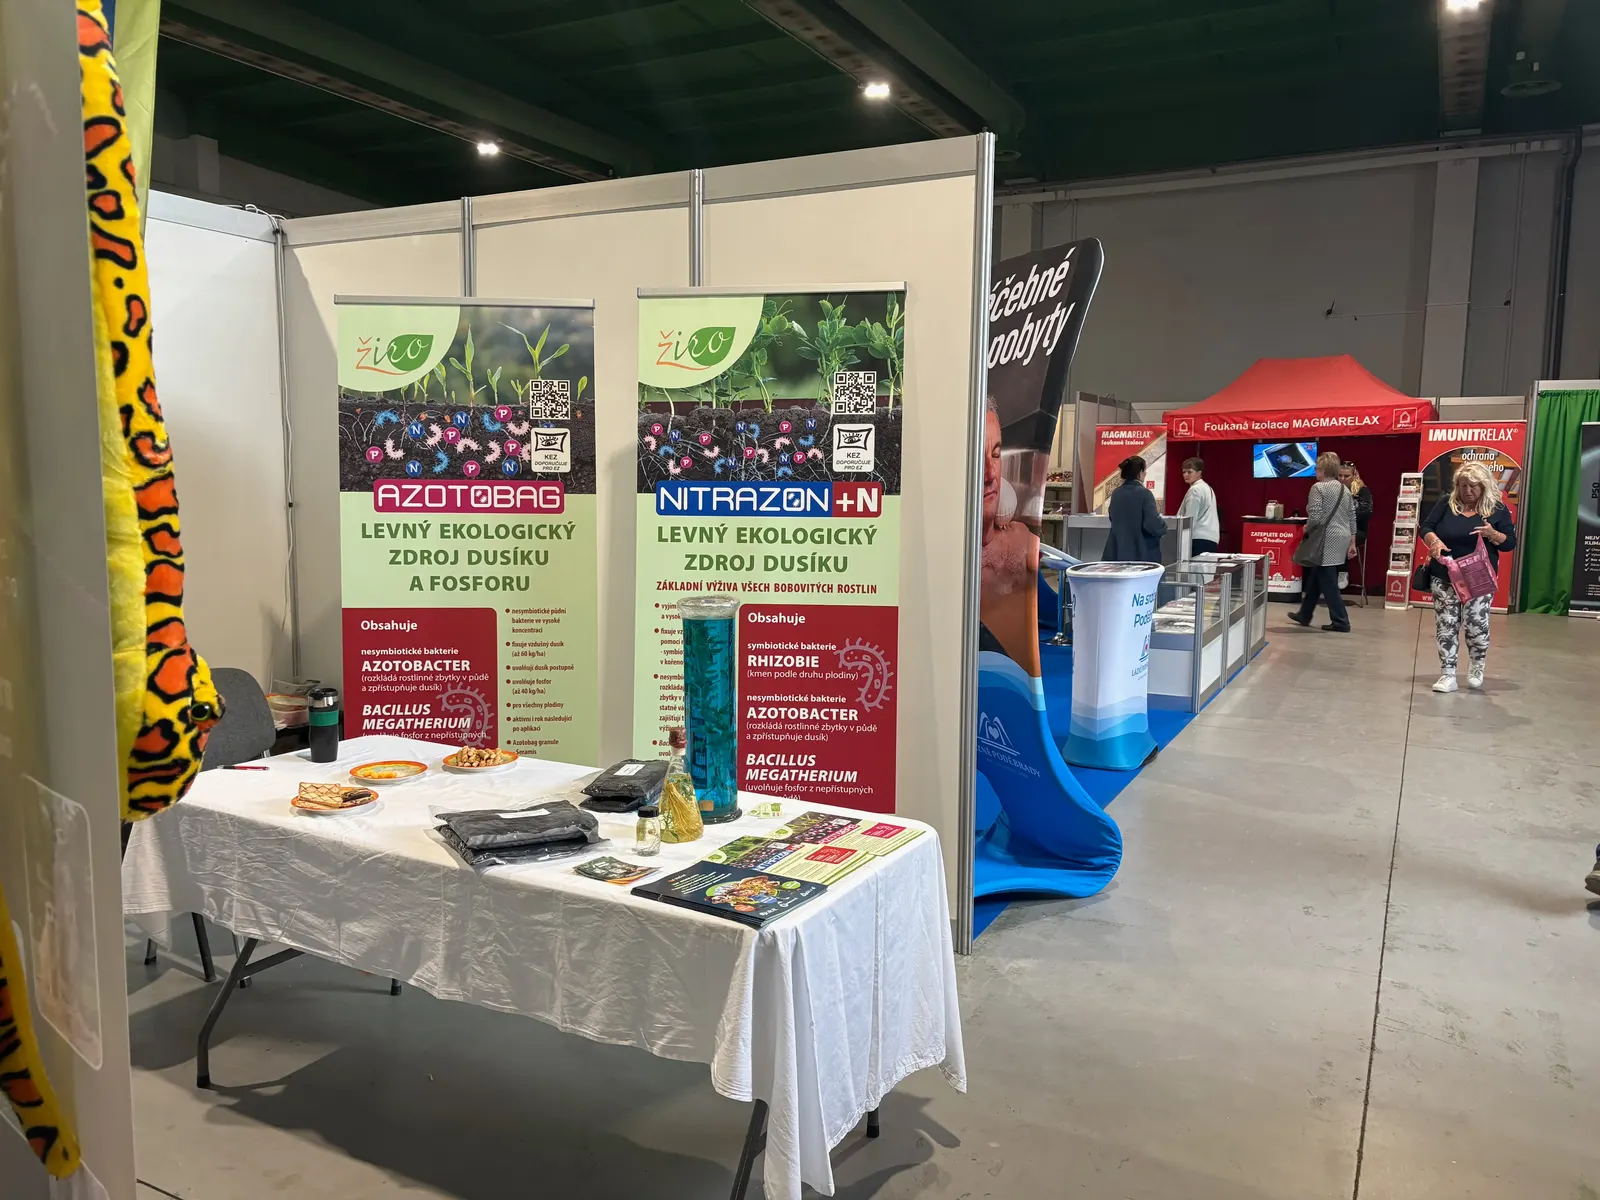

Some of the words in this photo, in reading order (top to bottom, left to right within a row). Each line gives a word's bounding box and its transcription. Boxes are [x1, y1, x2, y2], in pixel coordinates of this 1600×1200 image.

[457, 414, 466, 423] N
[499, 410, 507, 418] P
[412, 424, 421, 434] N
[1204, 420, 1249, 432] Foukaná
[1252, 418, 1289, 430] izolace
[1292, 416, 1380, 429] MAGMARELAX
[508, 444, 516, 452] P
[370, 451, 379, 459] P
[1462, 449, 1495, 460] ochrana
[410, 463, 419, 472] N
[467, 465, 475, 473] P
[505, 463, 513, 471] N
[378, 484, 560, 508] AZOTOBAG
[660, 487, 829, 512] NITRAZON
[362, 520, 431, 539] LEVNÝ
[440, 521, 576, 540] EKOLOGICKÝ
[658, 523, 728, 543] LEVNÝ
[736, 525, 878, 545] EKOLOGICKÝ
[389, 550, 459, 565] ZDROJ
[468, 547, 549, 565] DUSÍKU
[684, 554, 755, 571] ZDROJ
[764, 552, 848, 572] DUSÍKU
[409, 576, 424, 591] A
[430, 576, 530, 591] FOSFORU
[656, 580, 703, 591] ZÁKLADNÍ
[707, 580, 738, 592] VÝŽIVA
[742, 581, 770, 592] VŠECH
[774, 581, 833, 593] BOBOVITÝCH
[837, 584, 877, 594] ROSTLIN
[1132, 593, 1144, 607] Na
[748, 612, 806, 626] Obsahuje
[361, 620, 418, 632] Obsahuje
[748, 642, 798, 650] symbiotické
[361, 648, 422, 656] nesymbiotické
[362, 660, 470, 672] AZOTOBACTER
[748, 655, 819, 667] RHIZOBIE
[362, 674, 397, 682] (rozkládá
[435, 674, 460, 682] zbytky
[469, 673, 489, 682] půdě
[774, 670, 797, 679] podle
[826, 671, 858, 680] plodiny)
[368, 684, 417, 693] zpřístupňuje
[747, 694, 808, 702] nesymbiotické
[811, 694, 846, 703] bakterie
[362, 704, 430, 715] BACILLUS
[747, 707, 858, 720] AZOTOBACTER
[362, 718, 470, 730] MEGATHERIUM
[746, 722, 782, 730] (rozkládá
[785, 722, 819, 730] rostlinné
[822, 723, 847, 732] zbytky
[856, 724, 877, 733] půdě
[431, 731, 486, 740] nepřístupných
[753, 732, 802, 742] zpřístupňuje
[805, 734, 828, 742] dusík)
[746, 754, 816, 766] BACILLUS
[746, 769, 857, 782] MEGATHERIUM
[746, 783, 782, 792] (uvolňuje
[785, 783, 807, 792] fosfor
[816, 784, 873, 794] nepřístupných
